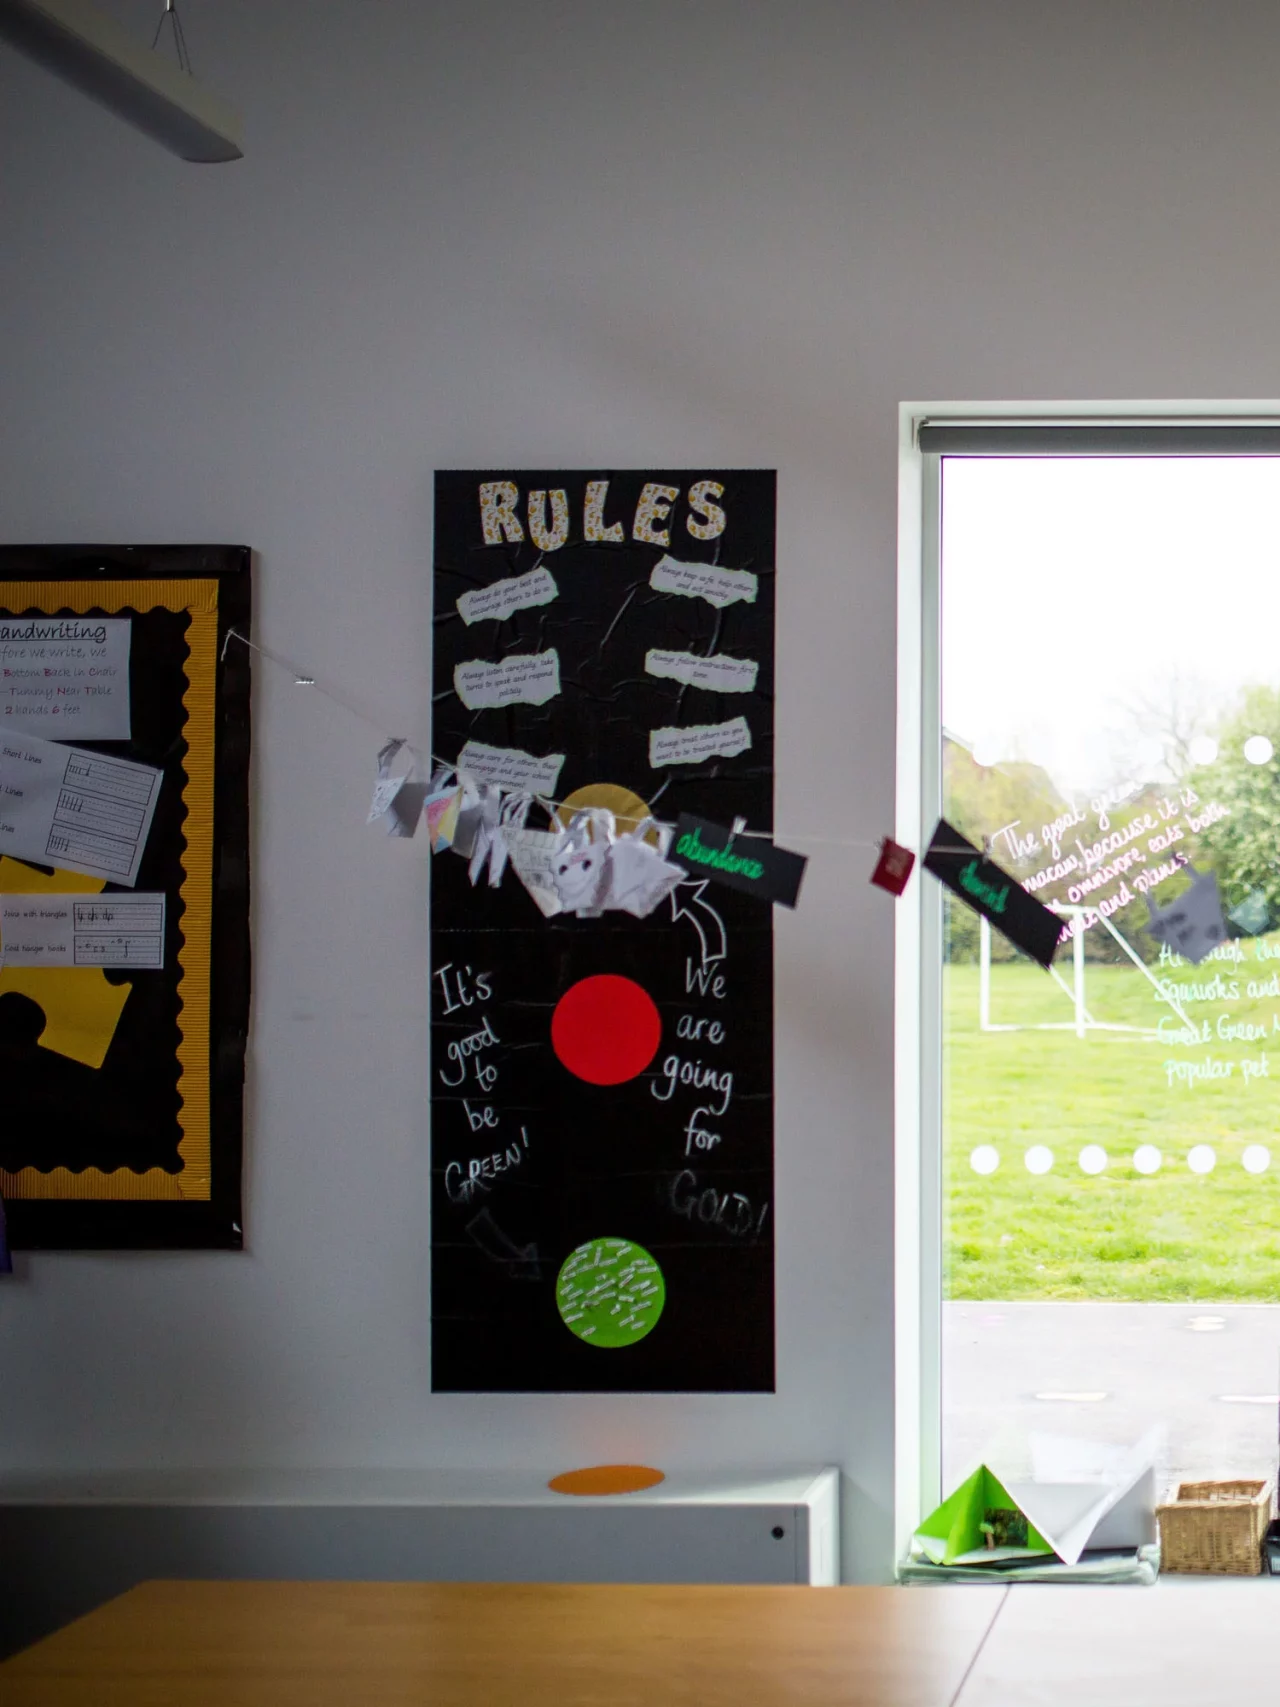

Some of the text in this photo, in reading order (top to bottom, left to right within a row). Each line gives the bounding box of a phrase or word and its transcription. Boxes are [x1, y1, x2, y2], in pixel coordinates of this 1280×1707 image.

[478, 480, 727, 552] RULES
[0, 622, 107, 644] andwriting
[29, 649, 46, 658] we
[91, 648, 107, 658] we
[44, 667, 71, 677] Back
[57, 687, 82, 696] Near
[84, 685, 113, 696] Table
[5, 706, 14, 714] 2
[52, 706, 60, 714] 6
[24, 753, 43, 764] Lines
[991, 806, 1087, 860] The great
[1075, 812, 1158, 873] because
[1155, 796, 1179, 820] it
[1179, 787, 1200, 808] is
[1148, 826, 1185, 857] eats
[1185, 802, 1234, 833] both
[1099, 883, 1137, 917] and
[433, 961, 494, 1016] It's
[685, 956, 727, 999] We
[676, 1013, 727, 1045] are
[1217, 1014, 1268, 1041] Green
[440, 1016, 500, 1087] good
[475, 1055, 498, 1092] to
[650, 1055, 733, 1116] going
[1161, 1052, 1269, 1089] popular pet
[463, 1099, 499, 1132] be
[684, 1105, 721, 1156] for
